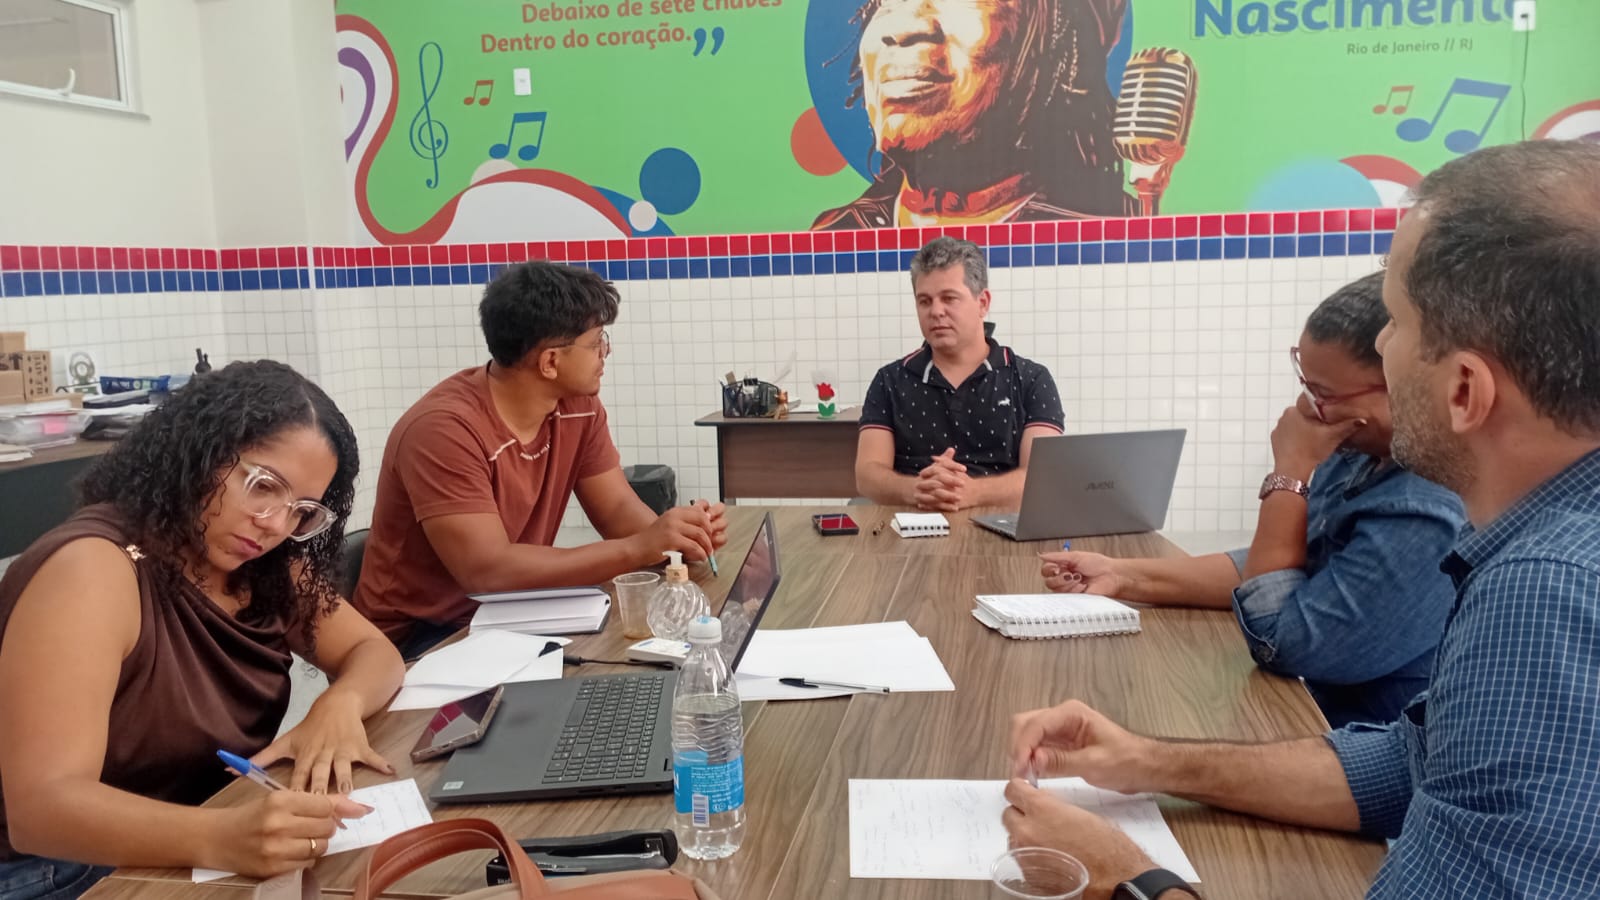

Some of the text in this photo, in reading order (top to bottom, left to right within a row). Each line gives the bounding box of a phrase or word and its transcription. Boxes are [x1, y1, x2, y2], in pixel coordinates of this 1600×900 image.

[522, 0, 610, 23] Debaixo
[617, 0, 643, 17] de
[650, 0, 695, 15] sete
[482, 30, 557, 53] Dentro
[563, 29, 590, 49] do
[1347, 42, 1369, 55] Rio
[1372, 42, 1389, 54] de
[1392, 40, 1440, 55] Janeiro
[1459, 37, 1473, 52] RJ
